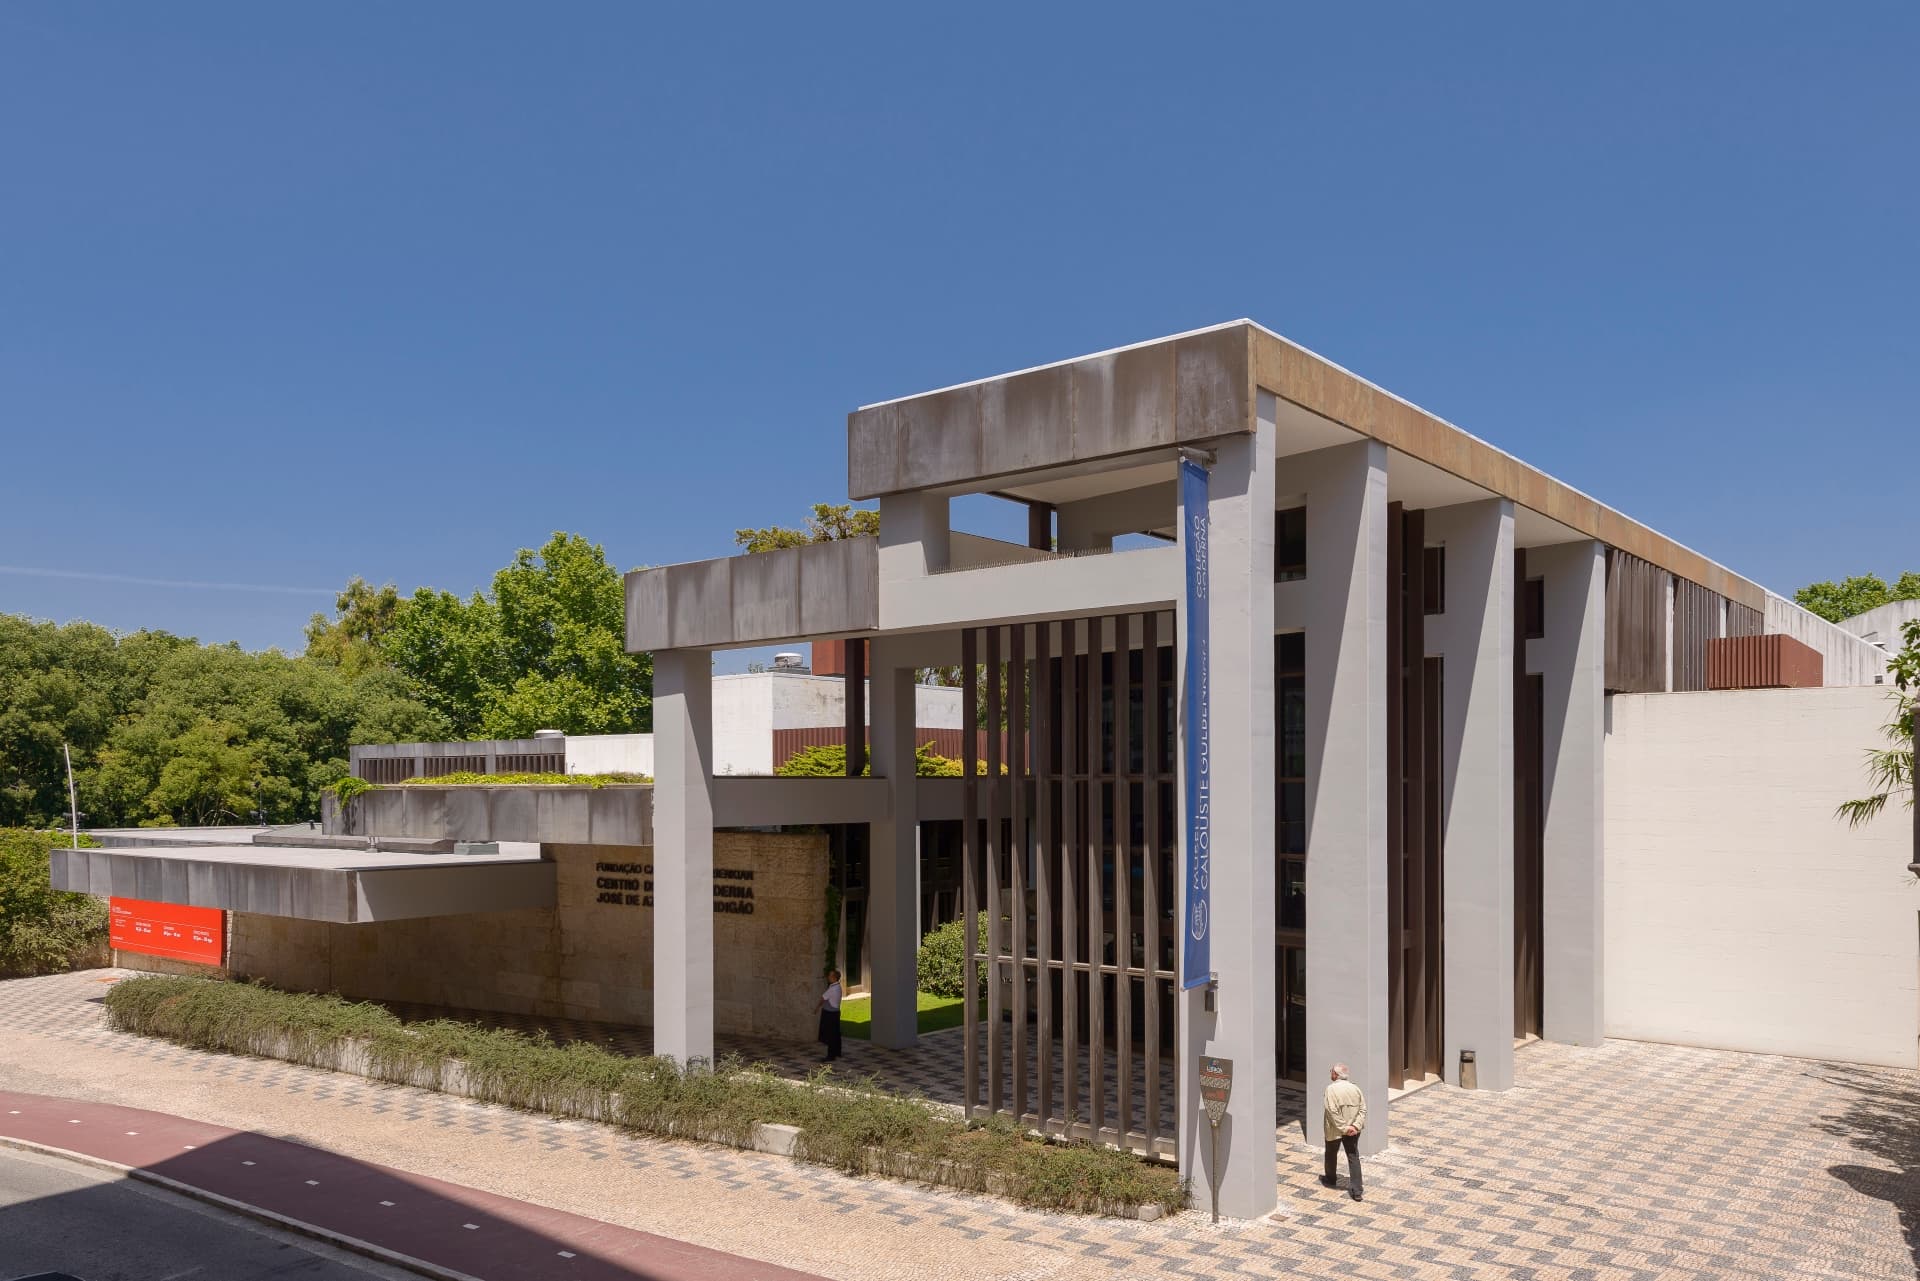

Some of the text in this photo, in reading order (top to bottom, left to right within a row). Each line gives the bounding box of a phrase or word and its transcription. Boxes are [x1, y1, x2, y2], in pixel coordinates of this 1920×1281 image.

[1200, 779, 1209, 890] CALOUSTE
[596, 862, 642, 876] FUNDAÇÃO
[596, 877, 640, 891] CENTRO
[713, 884, 754, 899] DERNA
[596, 892, 623, 905] JOSÉ
[625, 894, 641, 906] DE
